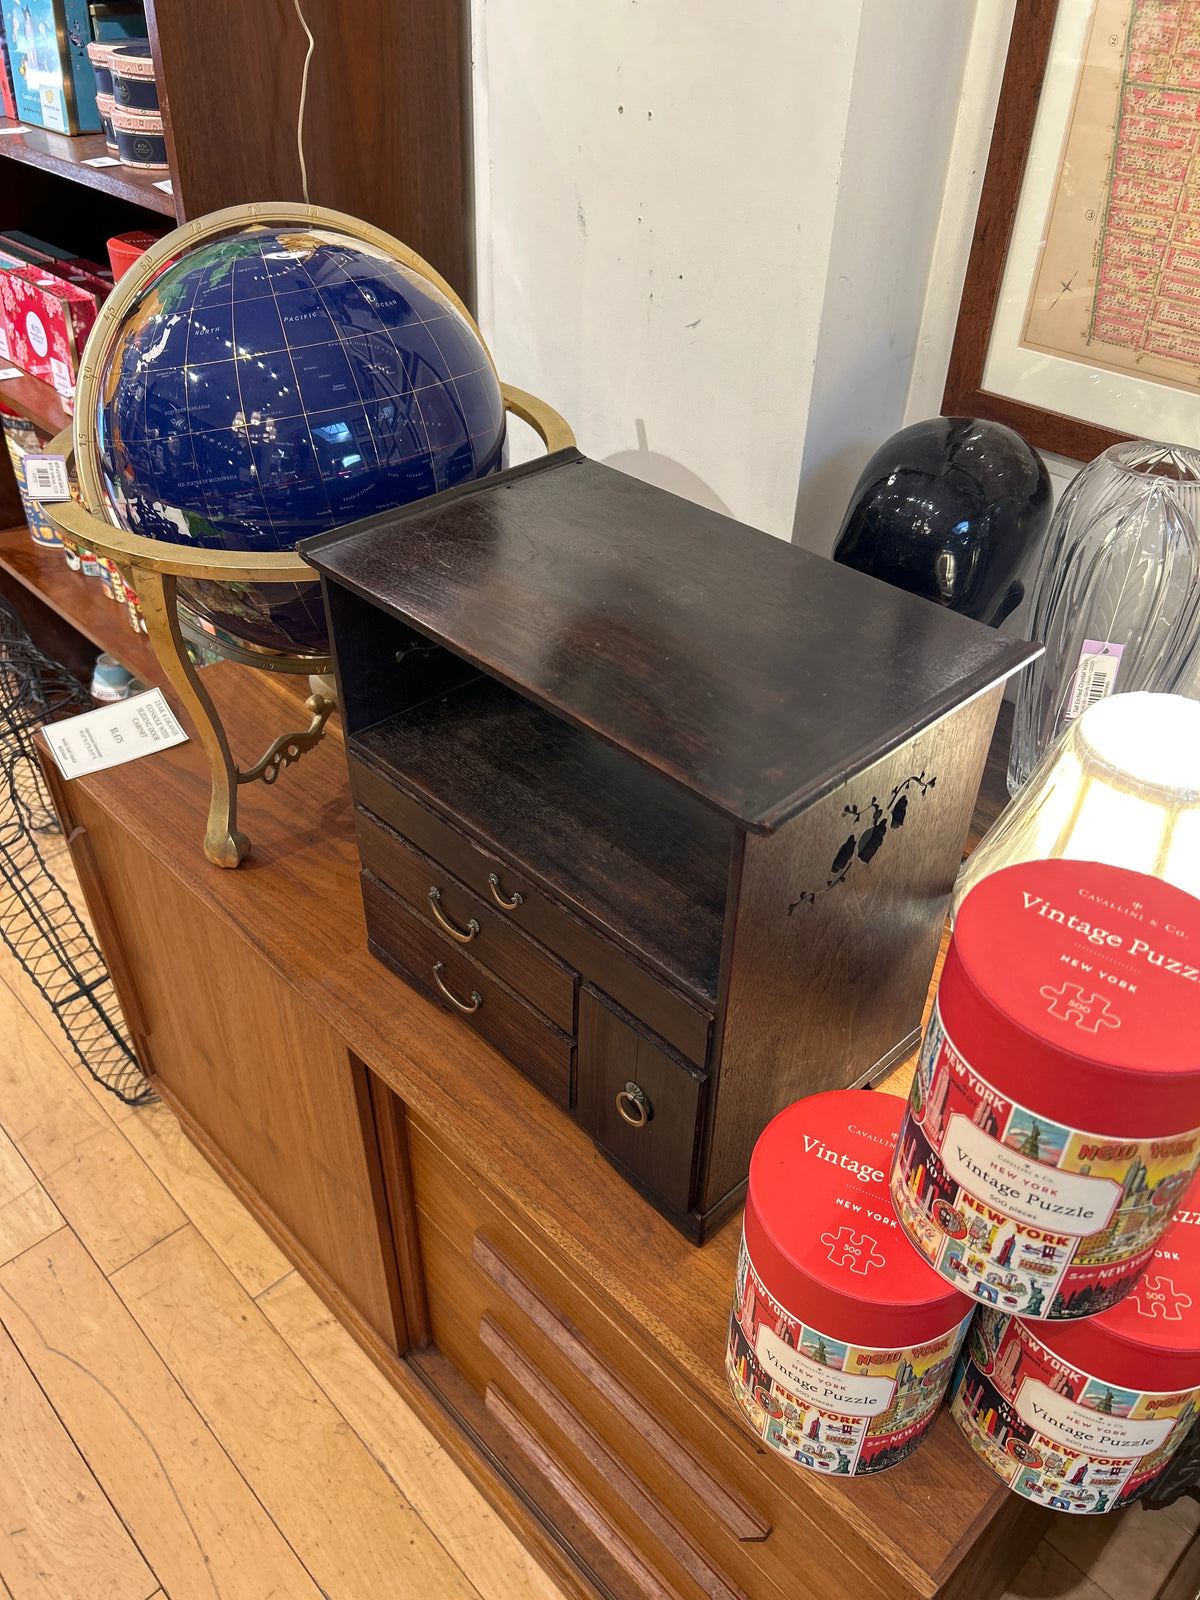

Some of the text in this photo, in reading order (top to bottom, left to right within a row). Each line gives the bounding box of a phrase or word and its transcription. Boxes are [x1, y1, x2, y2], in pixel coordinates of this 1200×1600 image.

[140, 254, 153, 270] 60
[104, 306, 116, 322] 45
[194, 299, 398, 336] NORTH PACIFIC OCEAN
[83, 366, 93, 381] 30
[79, 432, 87, 447] 15
[146, 703, 162, 726] CONSOLE
[132, 717, 148, 738] CABINET
[1149, 919, 1159, 928] &
[1022, 891, 1200, 984] Vintage Puzz
[1060, 954, 1138, 994] NEW YORK
[1068, 999, 1092, 1014] 500
[944, 1042, 1006, 1113] NEW YORK
[848, 1124, 897, 1150] CAVALLIN
[803, 1134, 885, 1182] Vintage
[1077, 1143, 1138, 1160] NEW
[957, 1146, 1094, 1219] Vintage Puzzle
[990, 1162, 1059, 1197] NEW YORK
[836, 1198, 898, 1228] NEW YORK
[989, 1194, 1037, 1220] 500 pieces
[962, 1193, 1008, 1225] NEW
[1015, 1223, 1071, 1247] YORK
[843, 1244, 861, 1256] 500
[1154, 1249, 1180, 1261] ORK
[1098, 1263, 1129, 1279] NEW
[750, 1268, 796, 1329] NEW YORK
[1145, 1291, 1166, 1301] 500
[856, 1352, 902, 1366] NEW
[1014, 1321, 1082, 1383] NEW YORK
[766, 1349, 878, 1405] Vintage Puzzle
[792, 1364, 847, 1391] NEW YORK
[775, 1385, 862, 1424] NEW YORK
[795, 1387, 834, 1408] 500 pieces
[890, 1427, 915, 1443] NEW
[1032, 1402, 1154, 1448] Vintage Puzzle
[1066, 1416, 1127, 1436] NEW YORK
[1038, 1435, 1133, 1467] NEW YORK
[1065, 1437, 1108, 1454] 500 pieces
